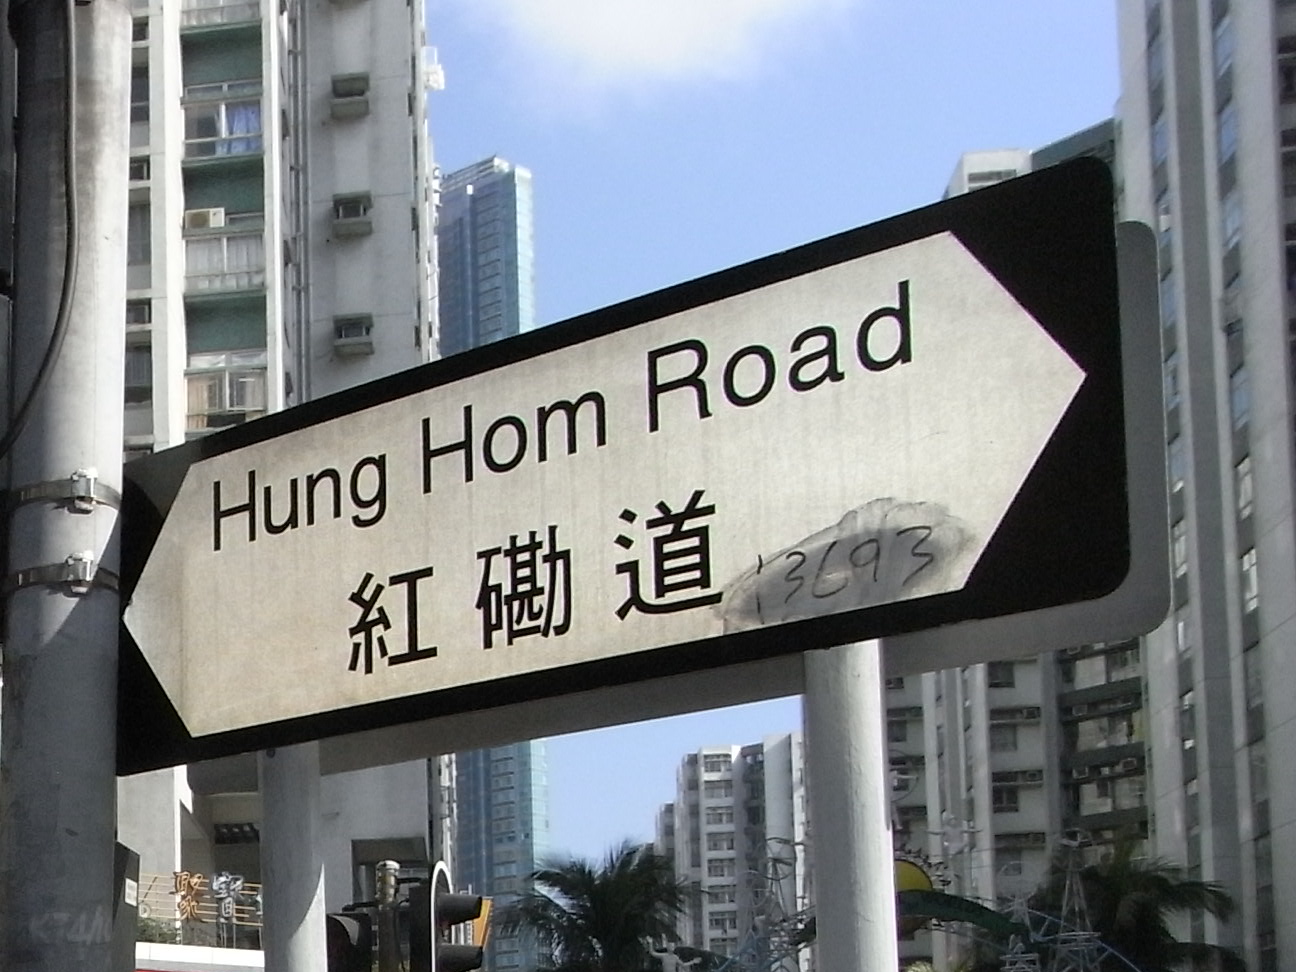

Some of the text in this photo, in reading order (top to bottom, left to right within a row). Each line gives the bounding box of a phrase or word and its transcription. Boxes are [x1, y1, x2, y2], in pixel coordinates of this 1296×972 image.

[213, 279, 912, 551] Hung Hom Road
[347, 489, 724, 675] 紅磡道
